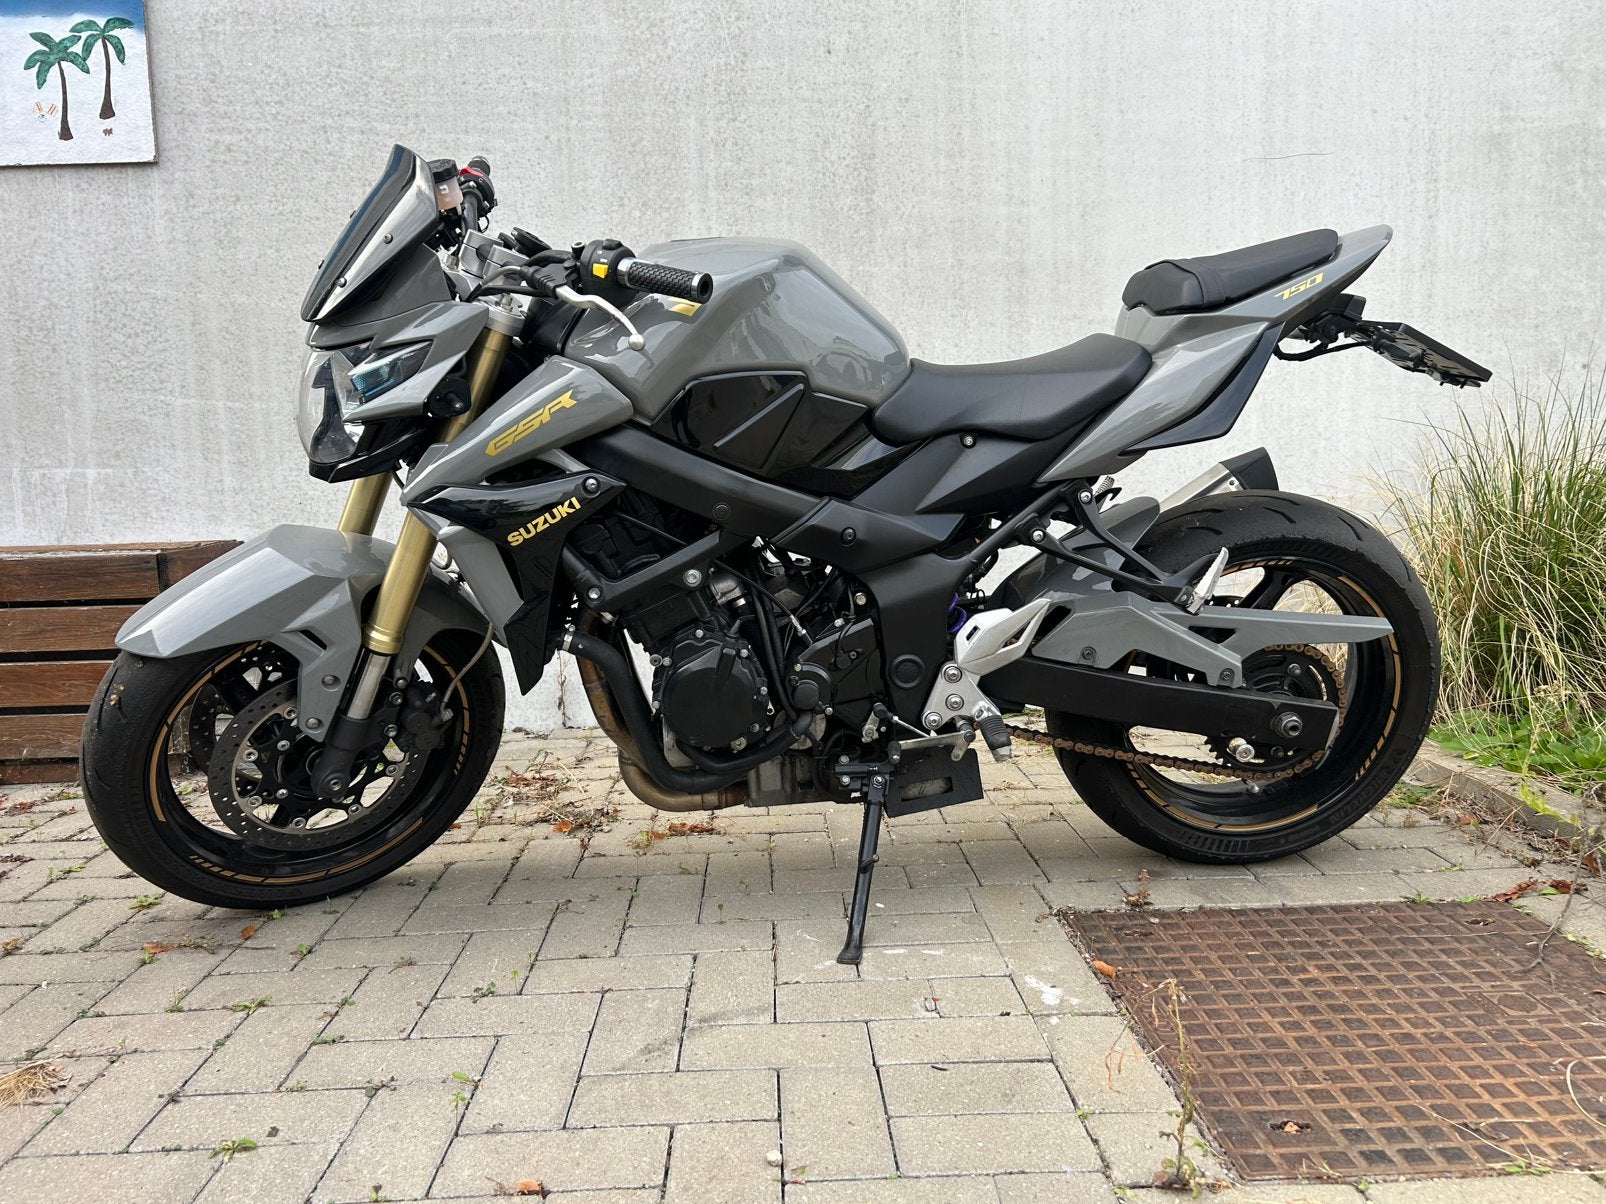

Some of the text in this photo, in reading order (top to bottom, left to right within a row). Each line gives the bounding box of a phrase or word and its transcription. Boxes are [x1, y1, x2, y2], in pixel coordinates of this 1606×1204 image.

[1274, 272, 1324, 300] 750
[484, 388, 578, 457] GSR
[507, 496, 582, 547] SUZUKI
